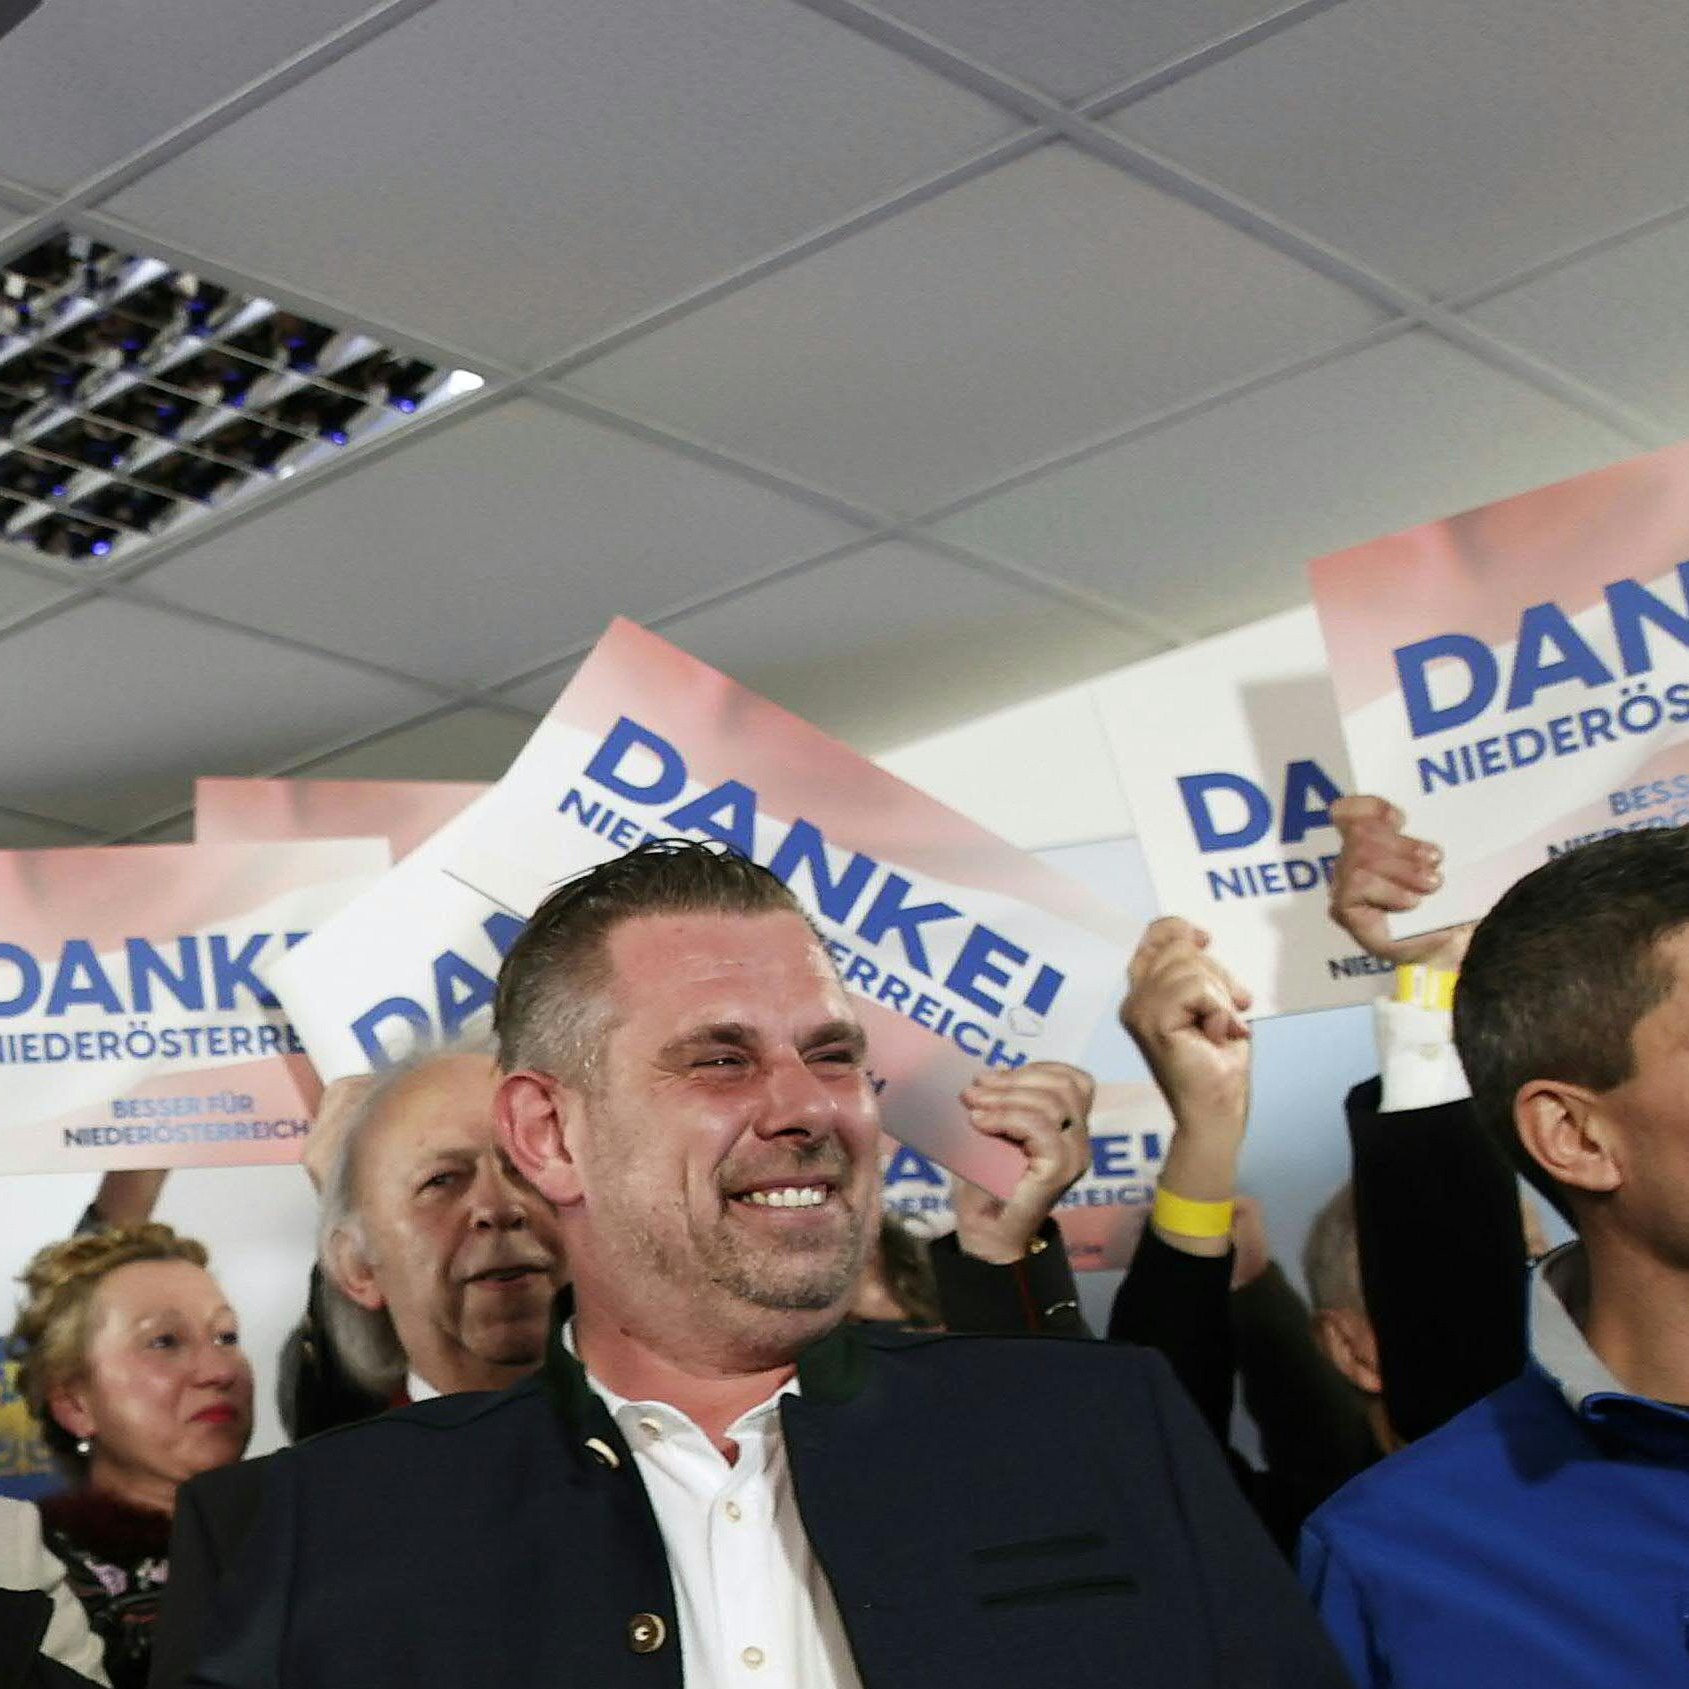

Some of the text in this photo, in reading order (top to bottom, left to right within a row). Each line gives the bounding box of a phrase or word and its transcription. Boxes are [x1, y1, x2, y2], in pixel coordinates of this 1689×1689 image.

[1393, 560, 1689, 739] DAN
[1418, 683, 1689, 794] NIEDERÖS
[583, 715, 1066, 1022] DANKE!
[63, 1119, 310, 1149] NIEDERÖSTERREICH
[111, 1088, 254, 1120] BESSER FÜR
